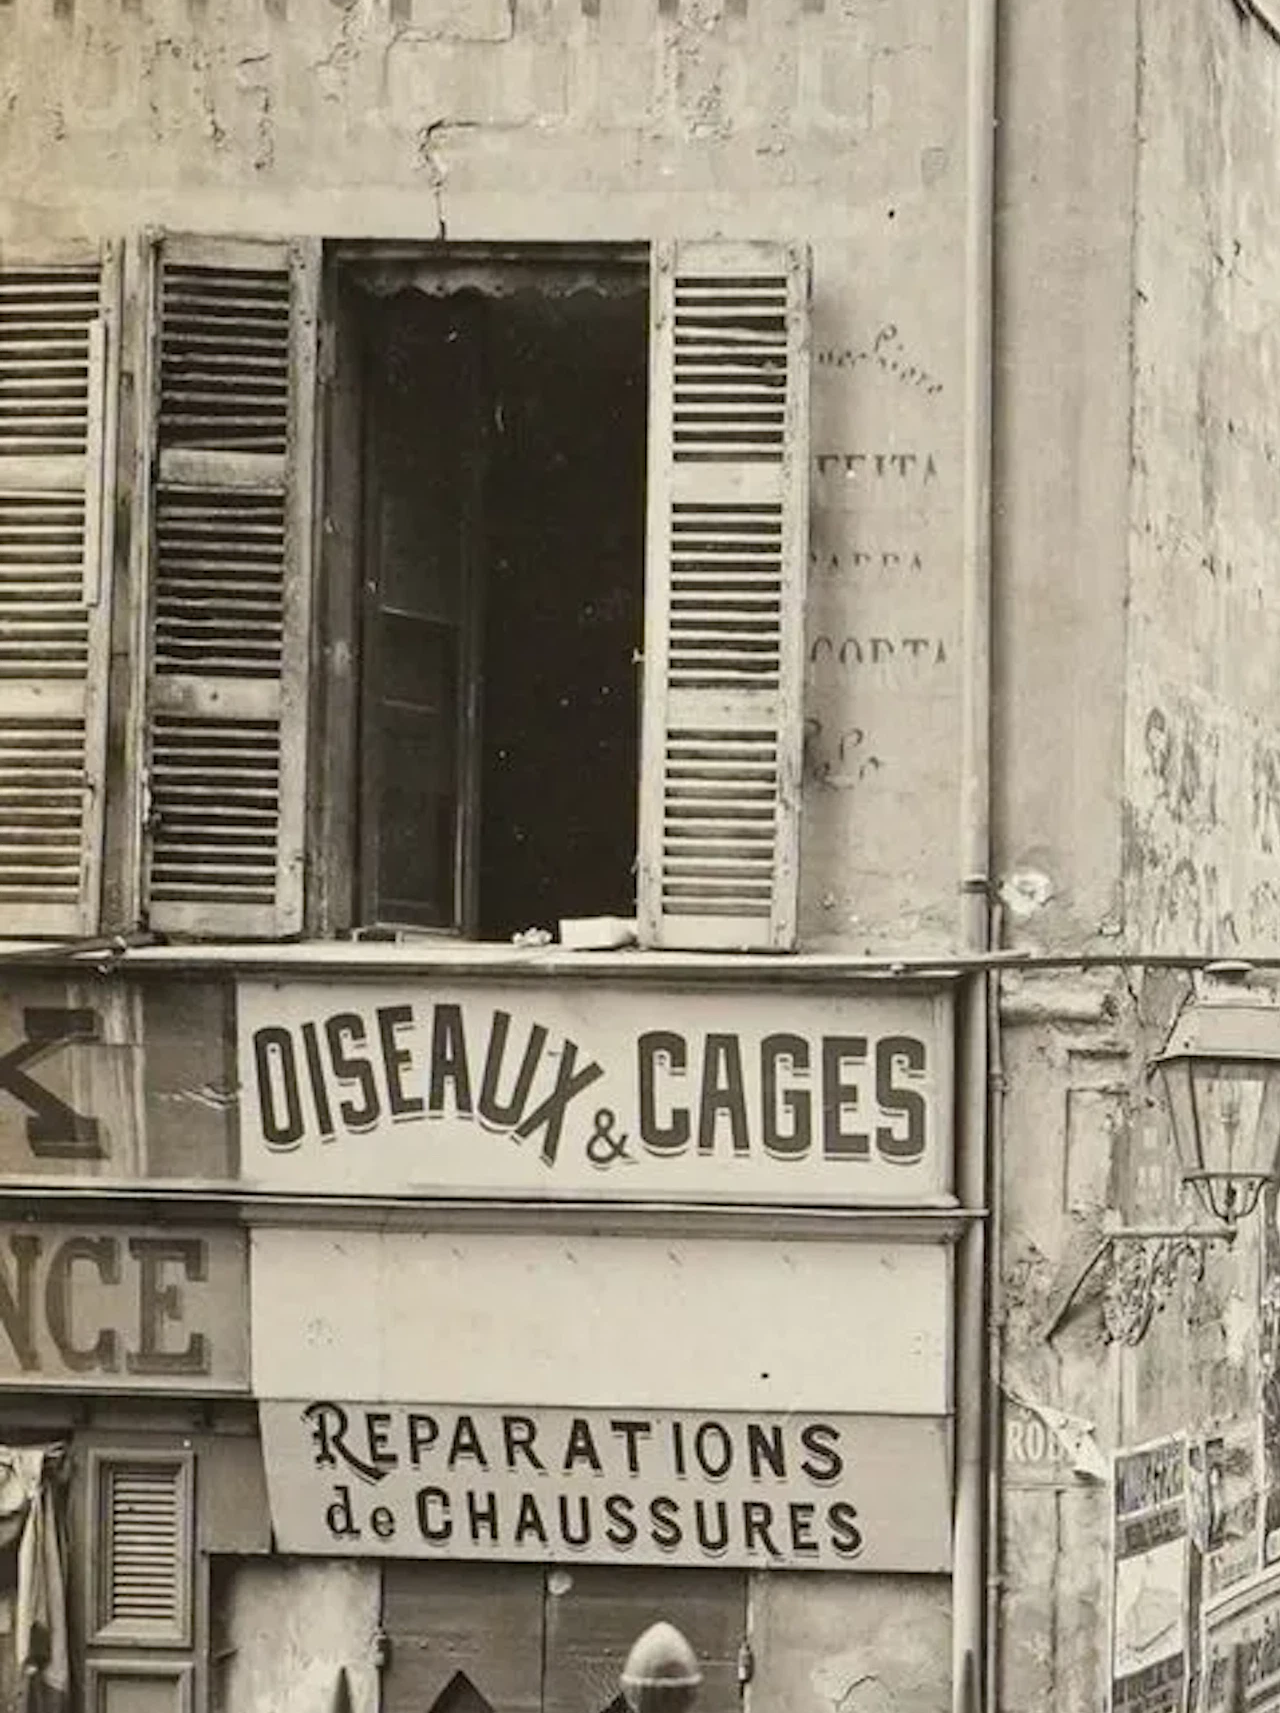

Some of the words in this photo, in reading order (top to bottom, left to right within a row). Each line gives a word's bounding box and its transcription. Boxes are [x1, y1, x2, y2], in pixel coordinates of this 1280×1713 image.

[253, 1003, 604, 1166] OISEAUX
[586, 1108, 632, 1164] &
[637, 1030, 927, 1162] CAGES
[304, 1401, 845, 1483] REPARATIONS
[326, 1485, 396, 1540] de
[416, 1488, 864, 1558] CHAUSSURES
